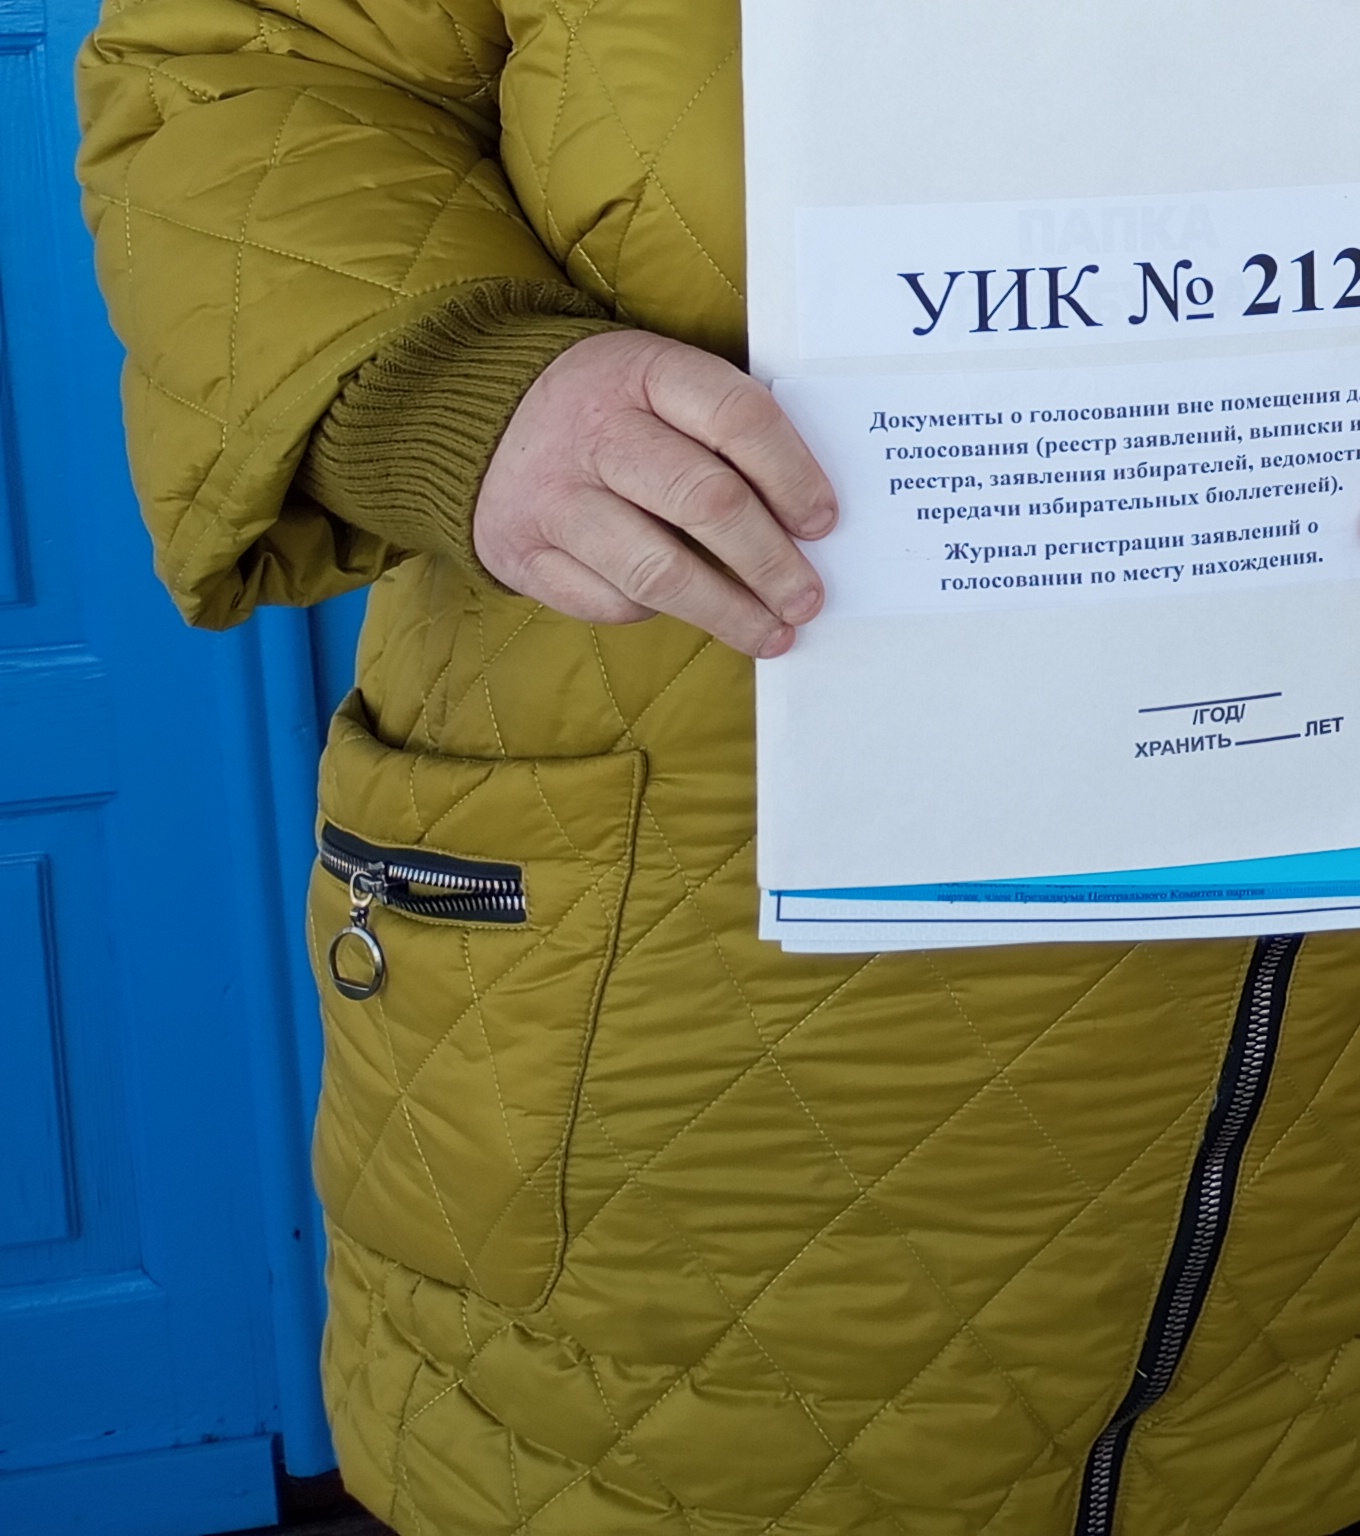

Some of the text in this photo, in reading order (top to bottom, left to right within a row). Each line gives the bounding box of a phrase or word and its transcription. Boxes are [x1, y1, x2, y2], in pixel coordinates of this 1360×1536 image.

[896, 263, 1104, 337] УИК
[1128, 259, 1216, 327] №
[869, 410, 1004, 433] Документы
[1010, 410, 1023, 425] о
[1029, 403, 1170, 425] голосовании
[1177, 397, 1215, 415] вне
[1220, 388, 1341, 413] помещения
[885, 440, 1029, 460] голосования
[1035, 436, 1117, 458] (реестр
[1122, 425, 1243, 451] заявлений,
[1249, 420, 1344, 440] выписки
[889, 473, 983, 495] реестра,
[989, 467, 1107, 487] заявления
[1113, 454, 1255, 482] избирателей,
[916, 474, 1344, 524] передачи избирательных бюллетеней).
[944, 519, 1320, 564] Журнал регистрации заявлений о
[940, 550, 1324, 591] голосовании по месту нахождения.
[1192, 703, 1246, 726] /ГОД/
[1134, 716, 1345, 759] ХРАНИТЬ ЛЕТ
